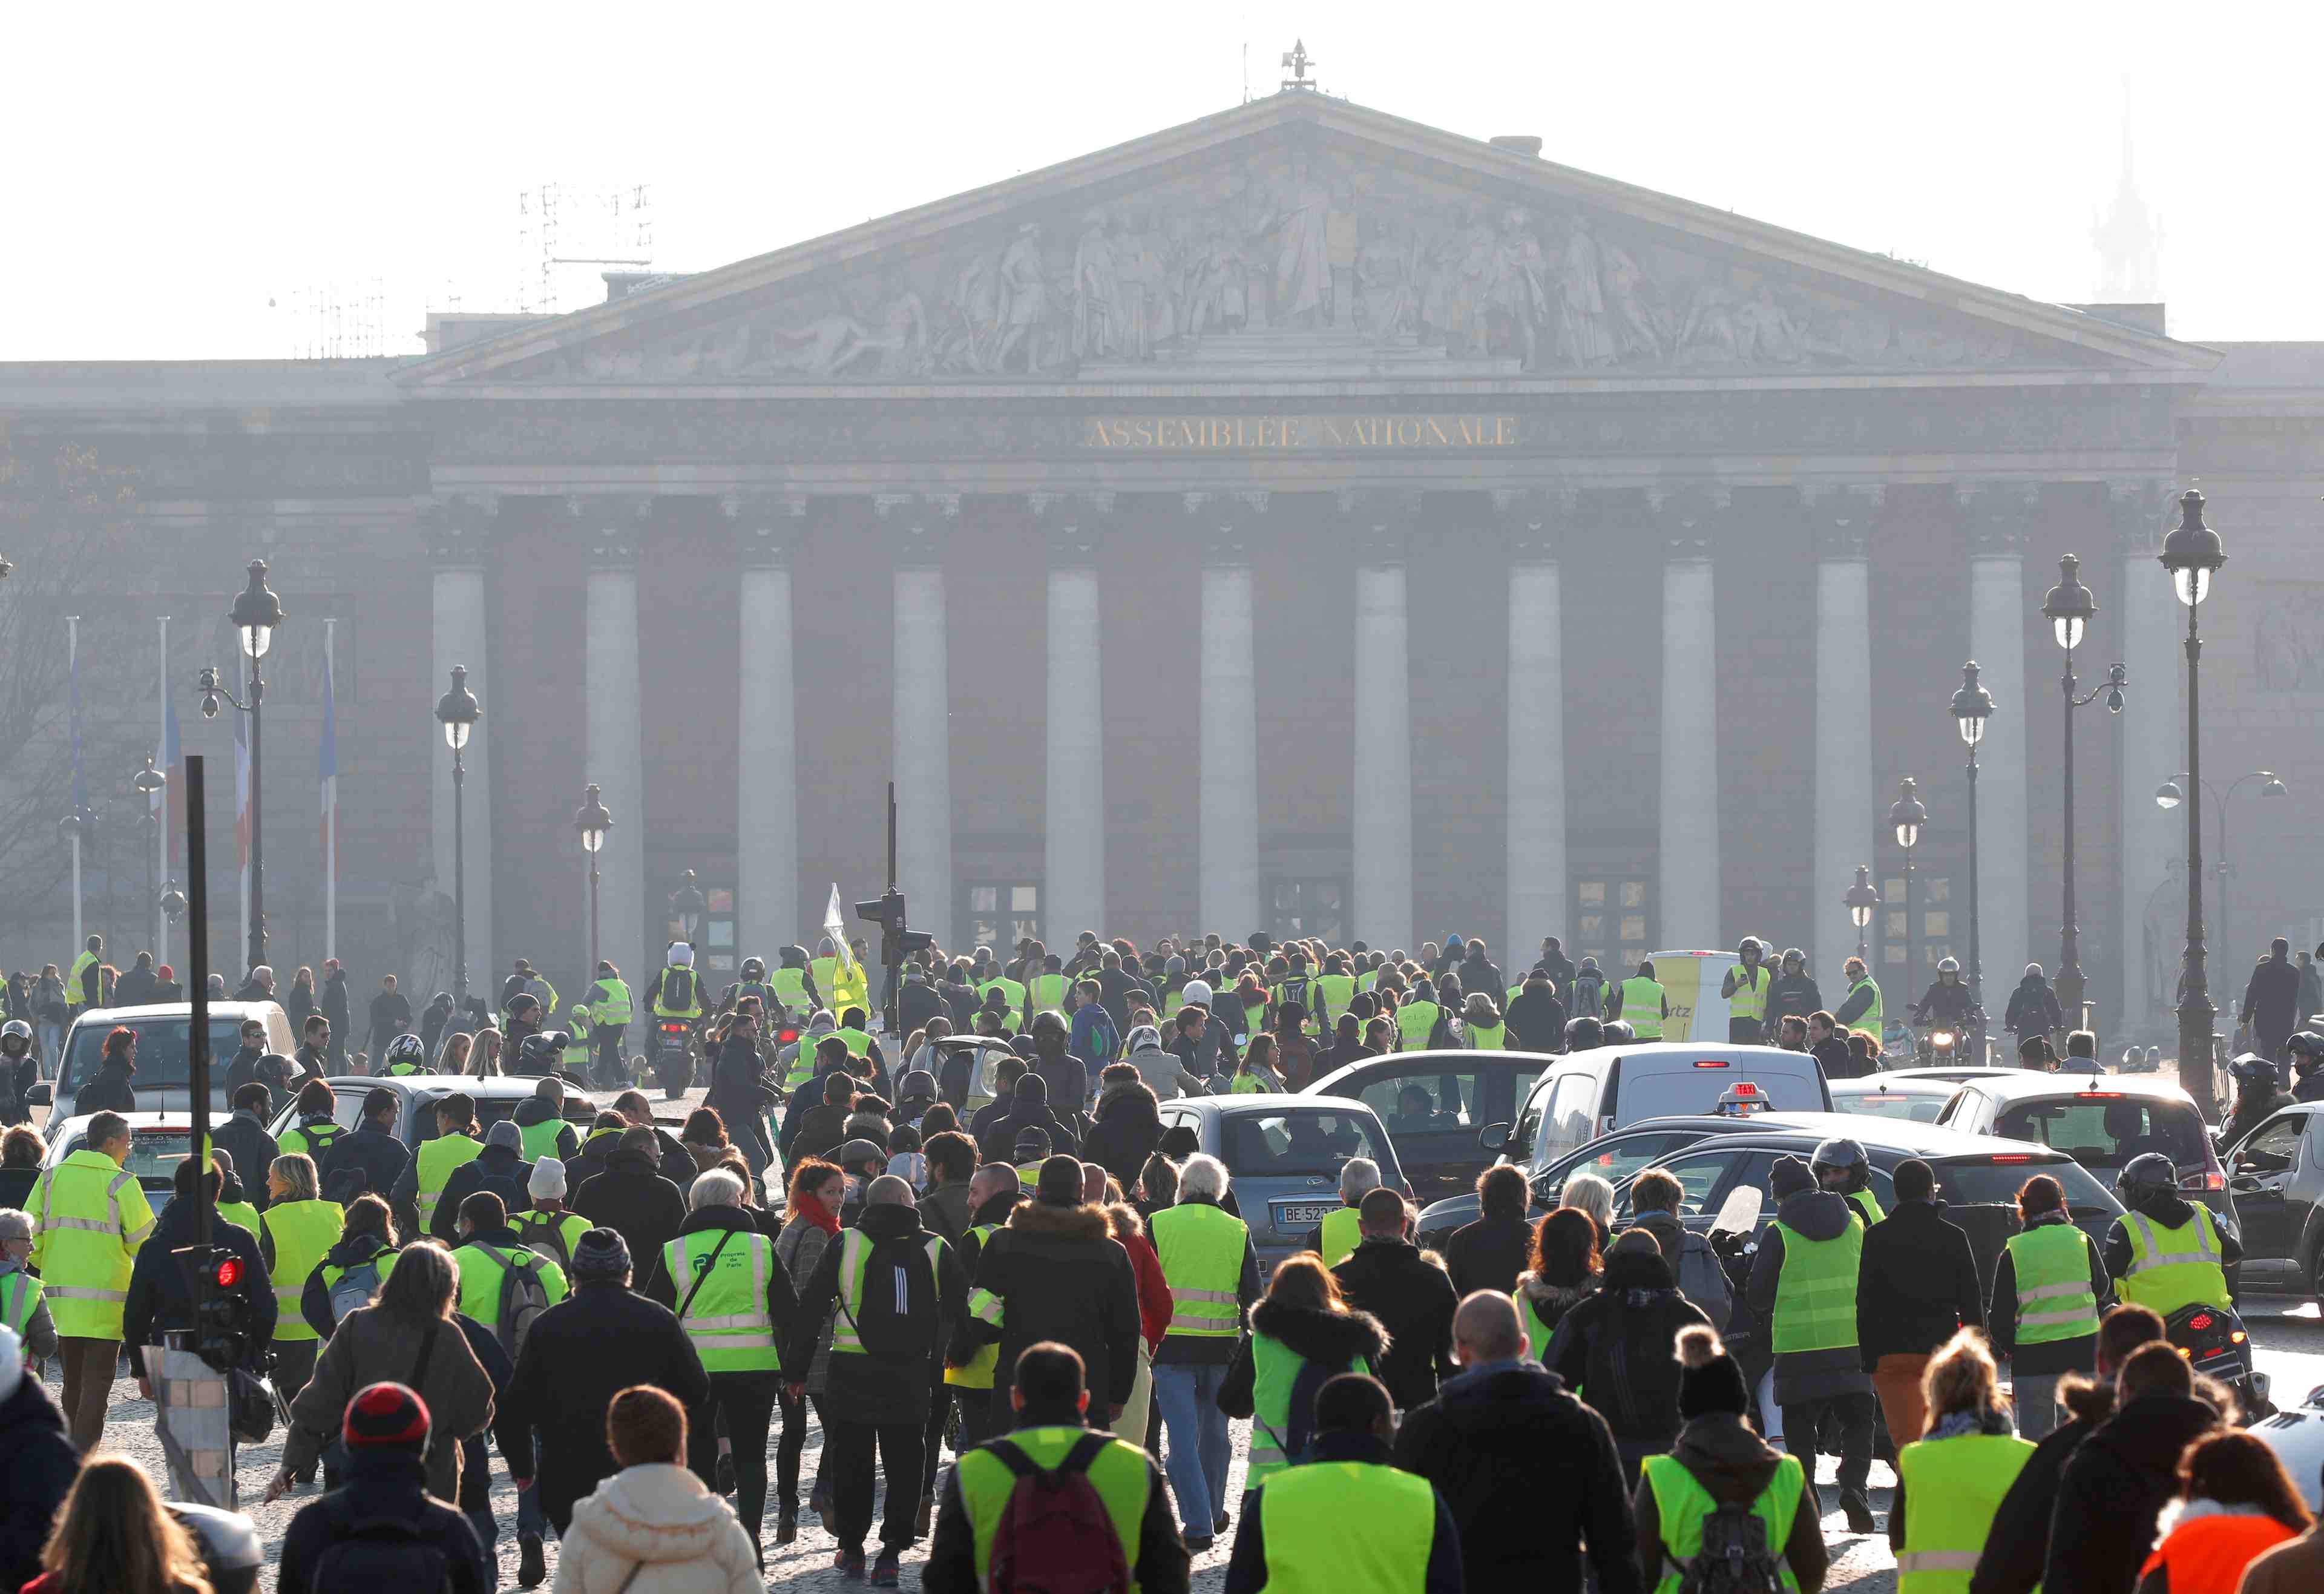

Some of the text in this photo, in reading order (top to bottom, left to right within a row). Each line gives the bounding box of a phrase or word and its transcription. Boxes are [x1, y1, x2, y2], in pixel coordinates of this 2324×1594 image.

[1319, 417, 1515, 446] NATIONALE
[1669, 1004, 1691, 1017] rtz
[1738, 1085, 1755, 1095] TAXI
